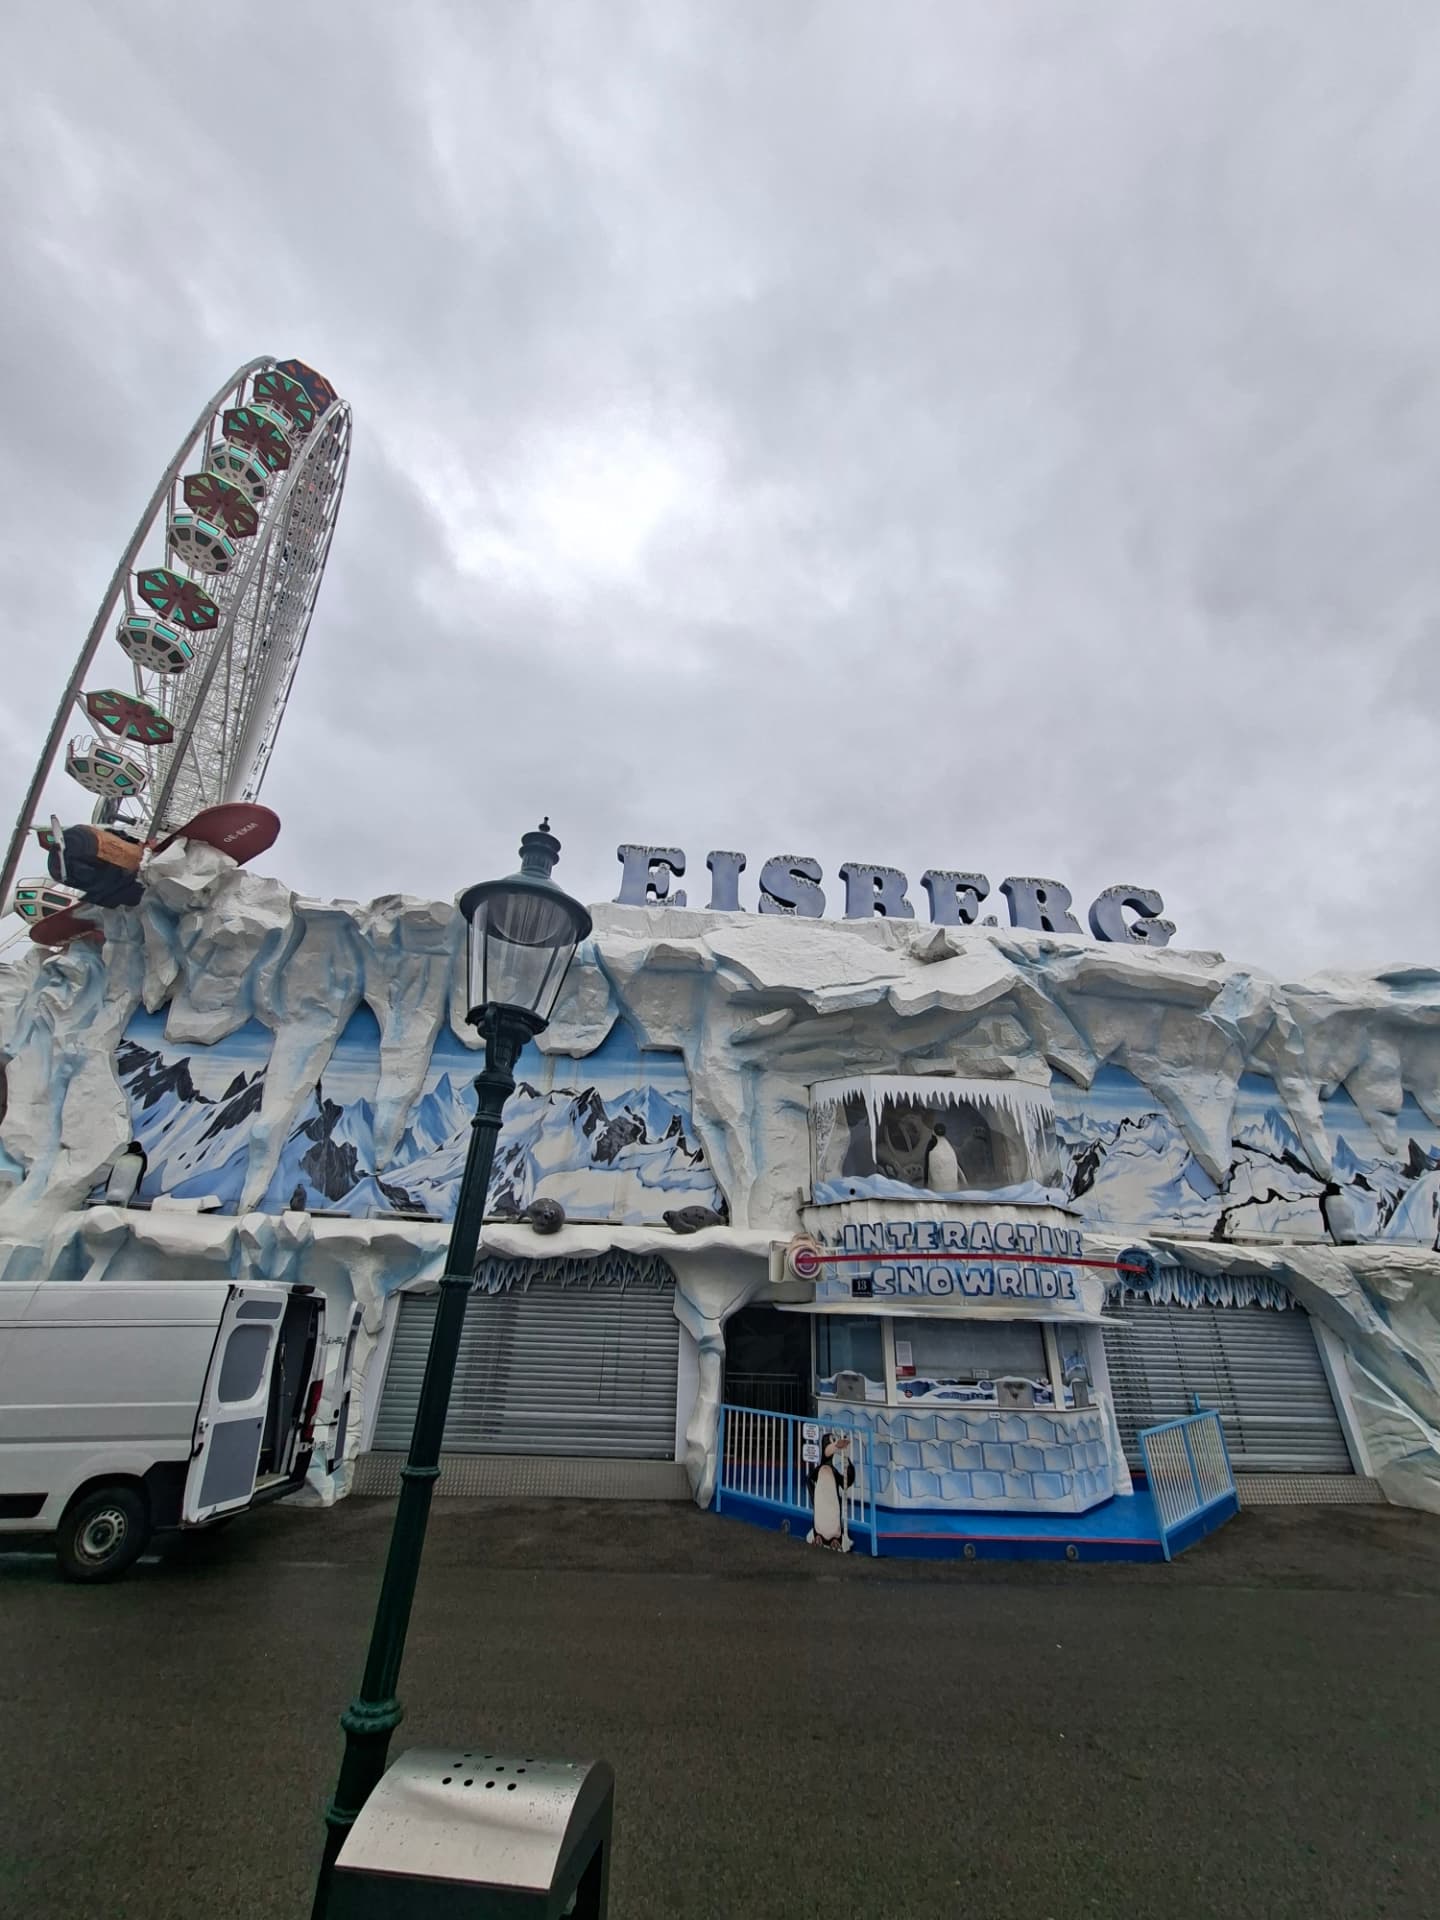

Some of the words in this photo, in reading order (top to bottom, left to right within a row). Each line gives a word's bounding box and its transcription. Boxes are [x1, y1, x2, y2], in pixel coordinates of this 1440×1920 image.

[613, 843, 1176, 948] EISBERG
[843, 1221, 1082, 1257] INTERACTIVE
[872, 1265, 1076, 1300] SNOWRIDE
